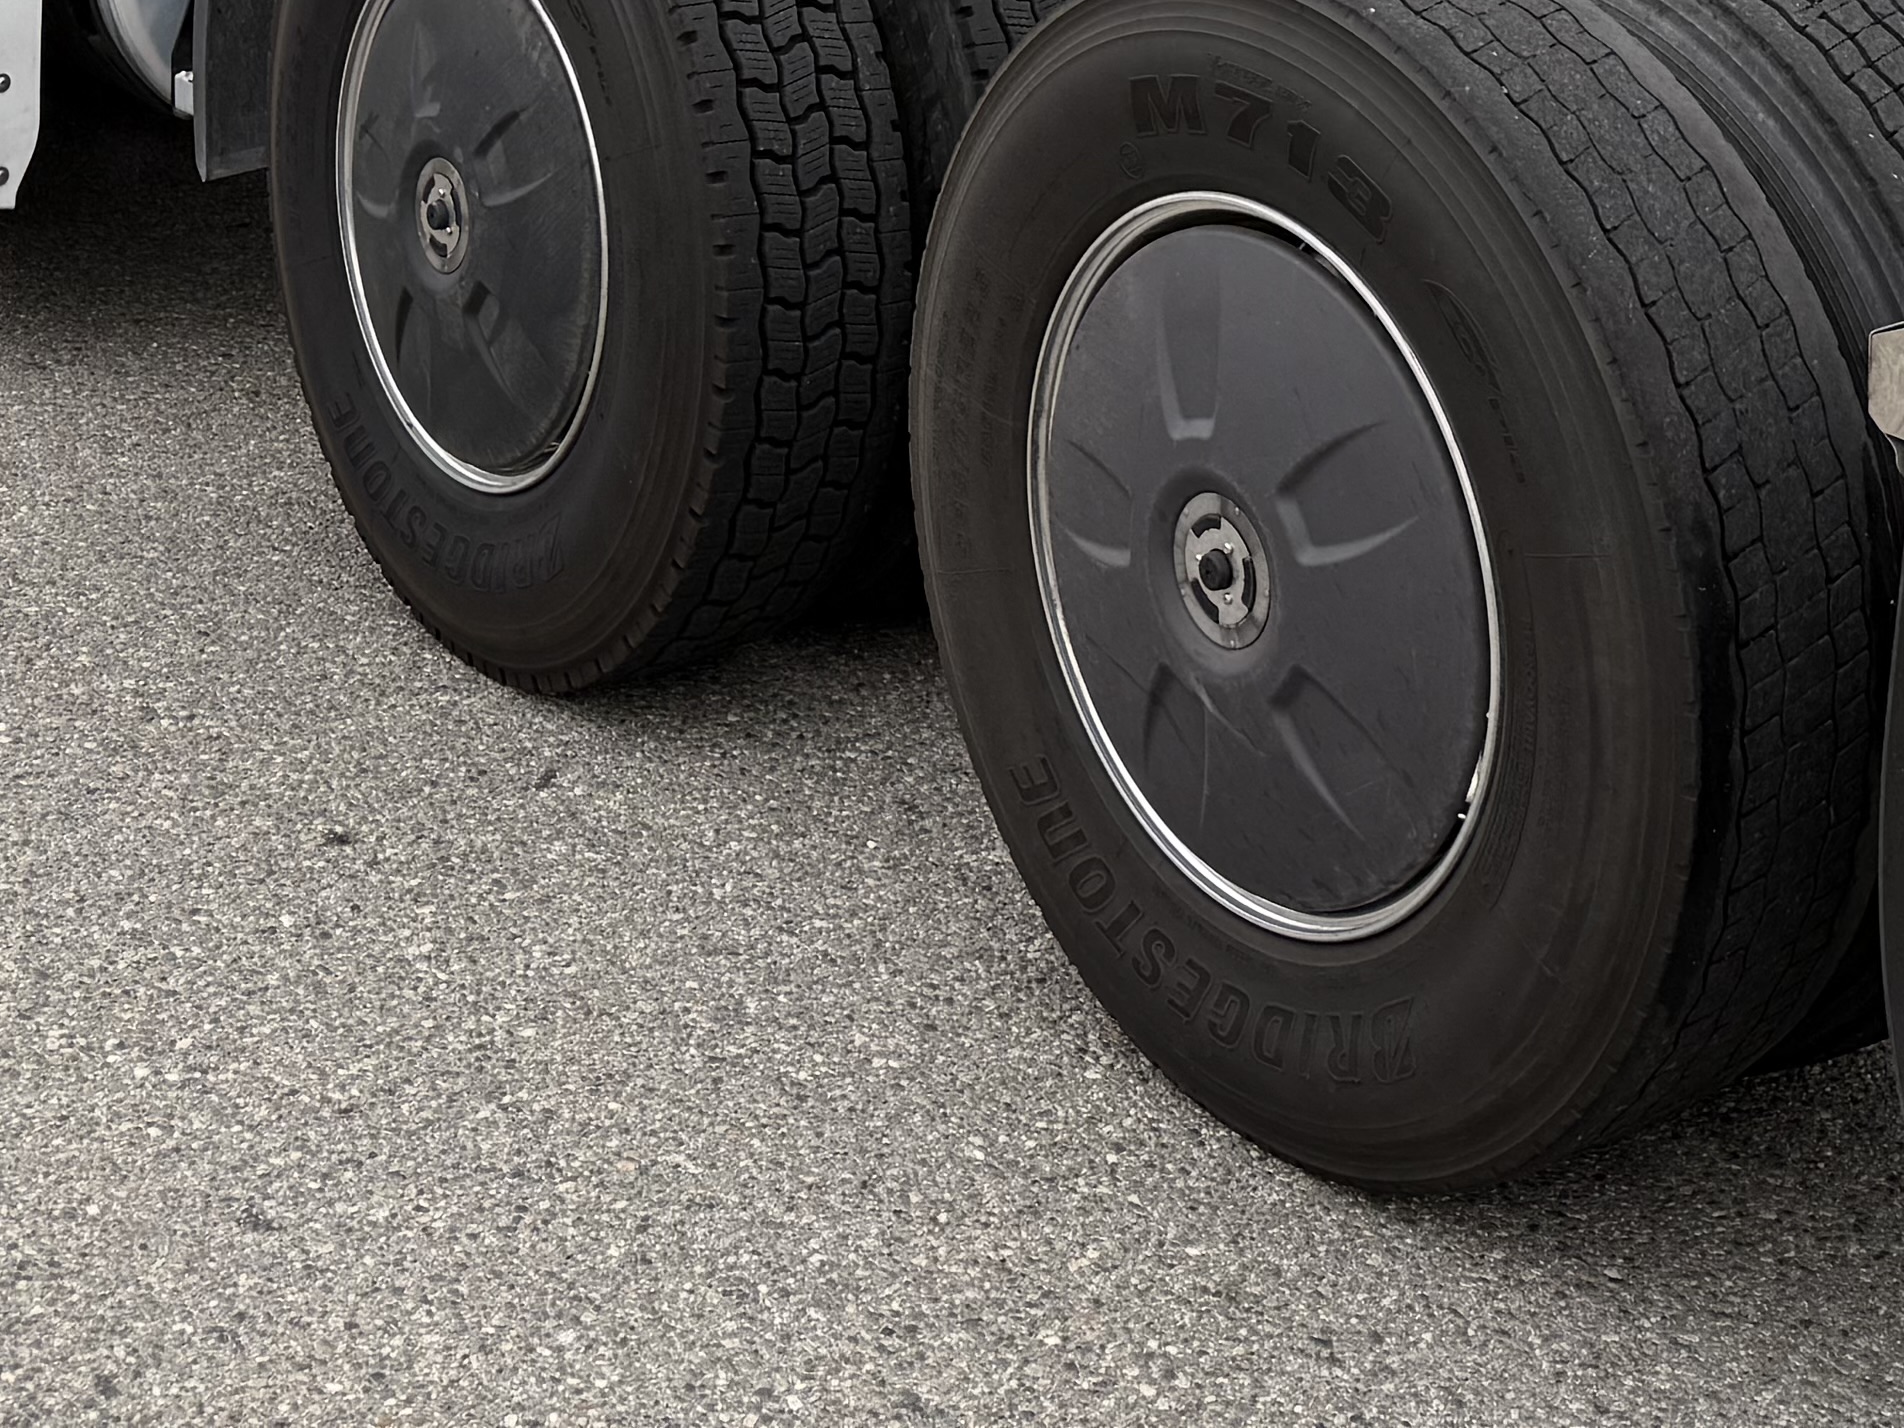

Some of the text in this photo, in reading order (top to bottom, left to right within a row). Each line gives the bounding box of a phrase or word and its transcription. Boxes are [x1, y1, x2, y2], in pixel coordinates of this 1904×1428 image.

[1129, 73, 1394, 244] M713
[327, 391, 565, 594] BRIDGESTONE
[1007, 753, 1418, 1082] BRIDGESTONE
